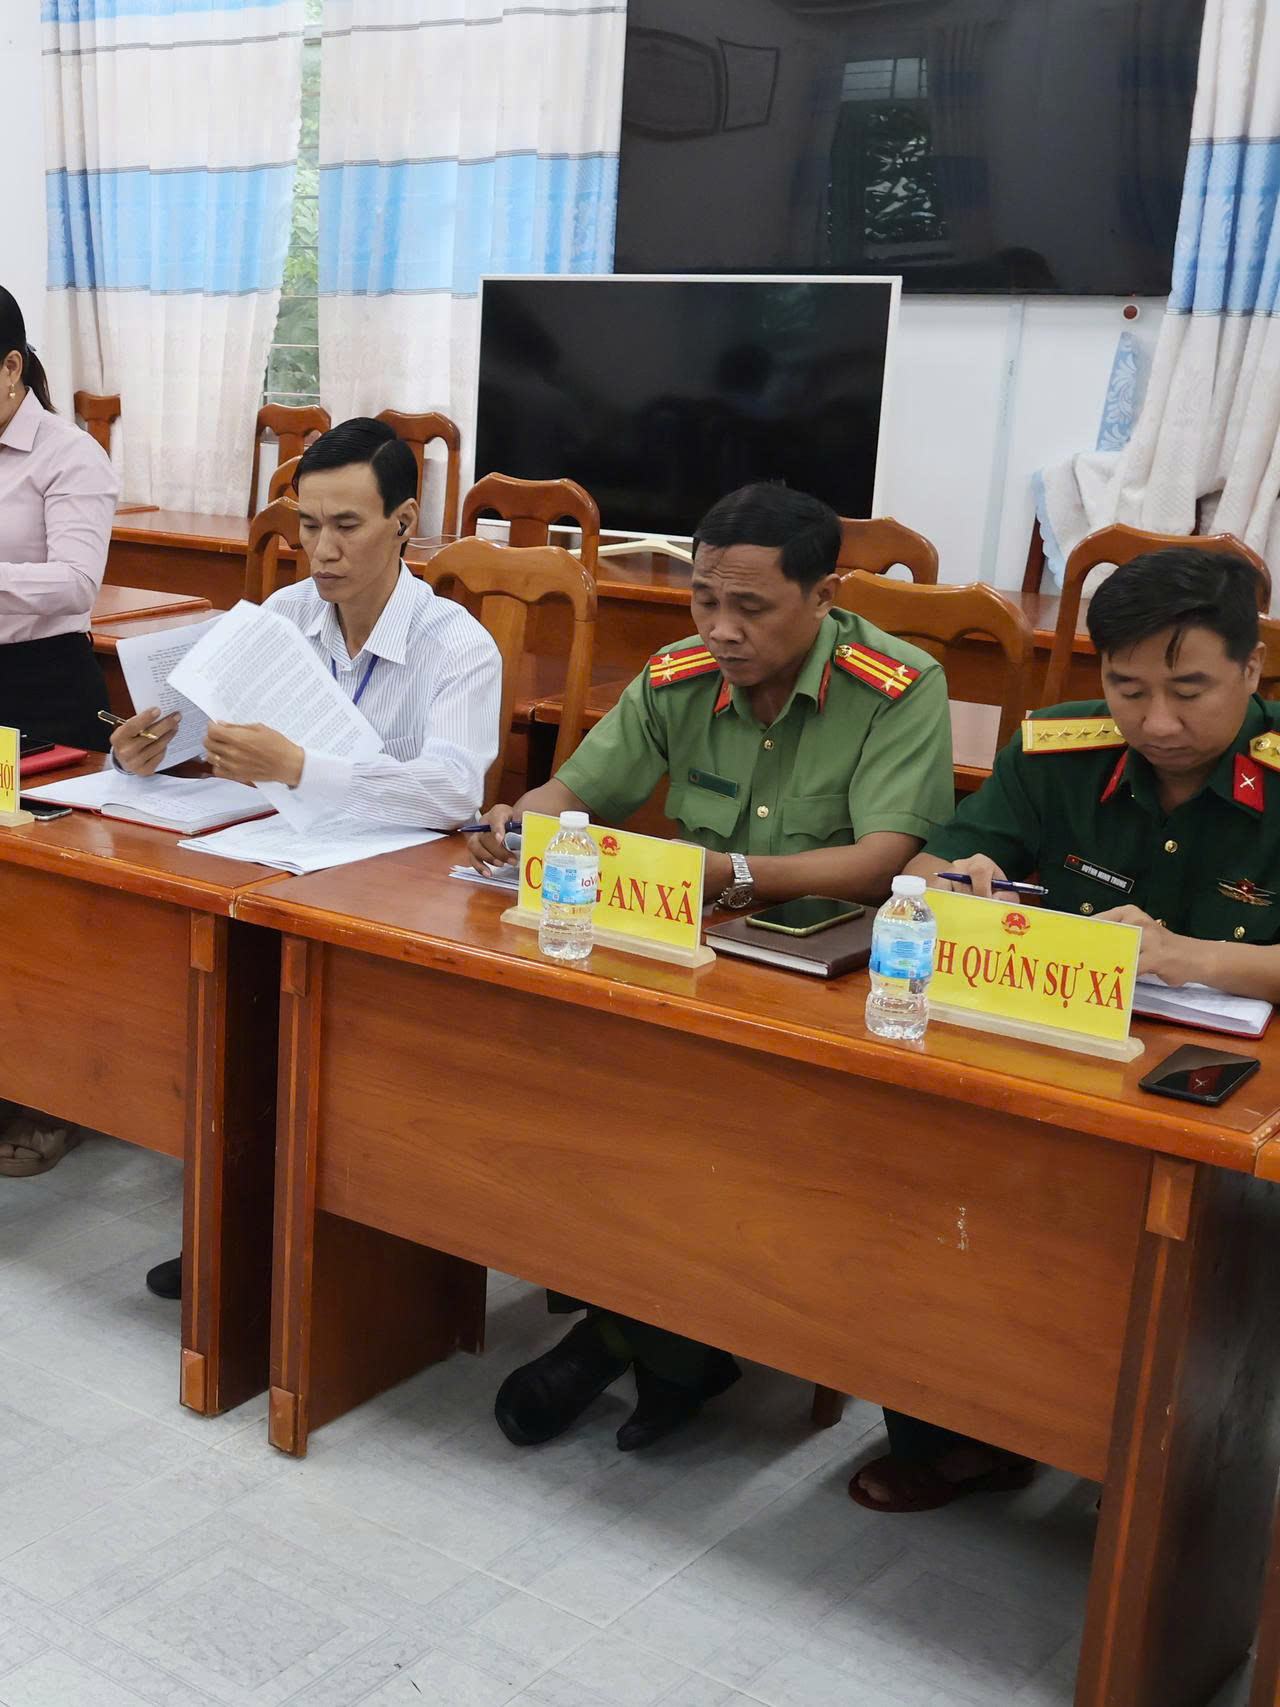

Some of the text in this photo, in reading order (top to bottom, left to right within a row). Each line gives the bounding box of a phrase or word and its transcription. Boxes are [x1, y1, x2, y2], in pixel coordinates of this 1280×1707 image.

[607, 876, 649, 915] AN
[654, 880, 696, 926] XÃ
[962, 943, 1040, 992] QUÂN
[1042, 961, 1085, 1010] SỰ
[1085, 965, 1125, 1011] XÃ
